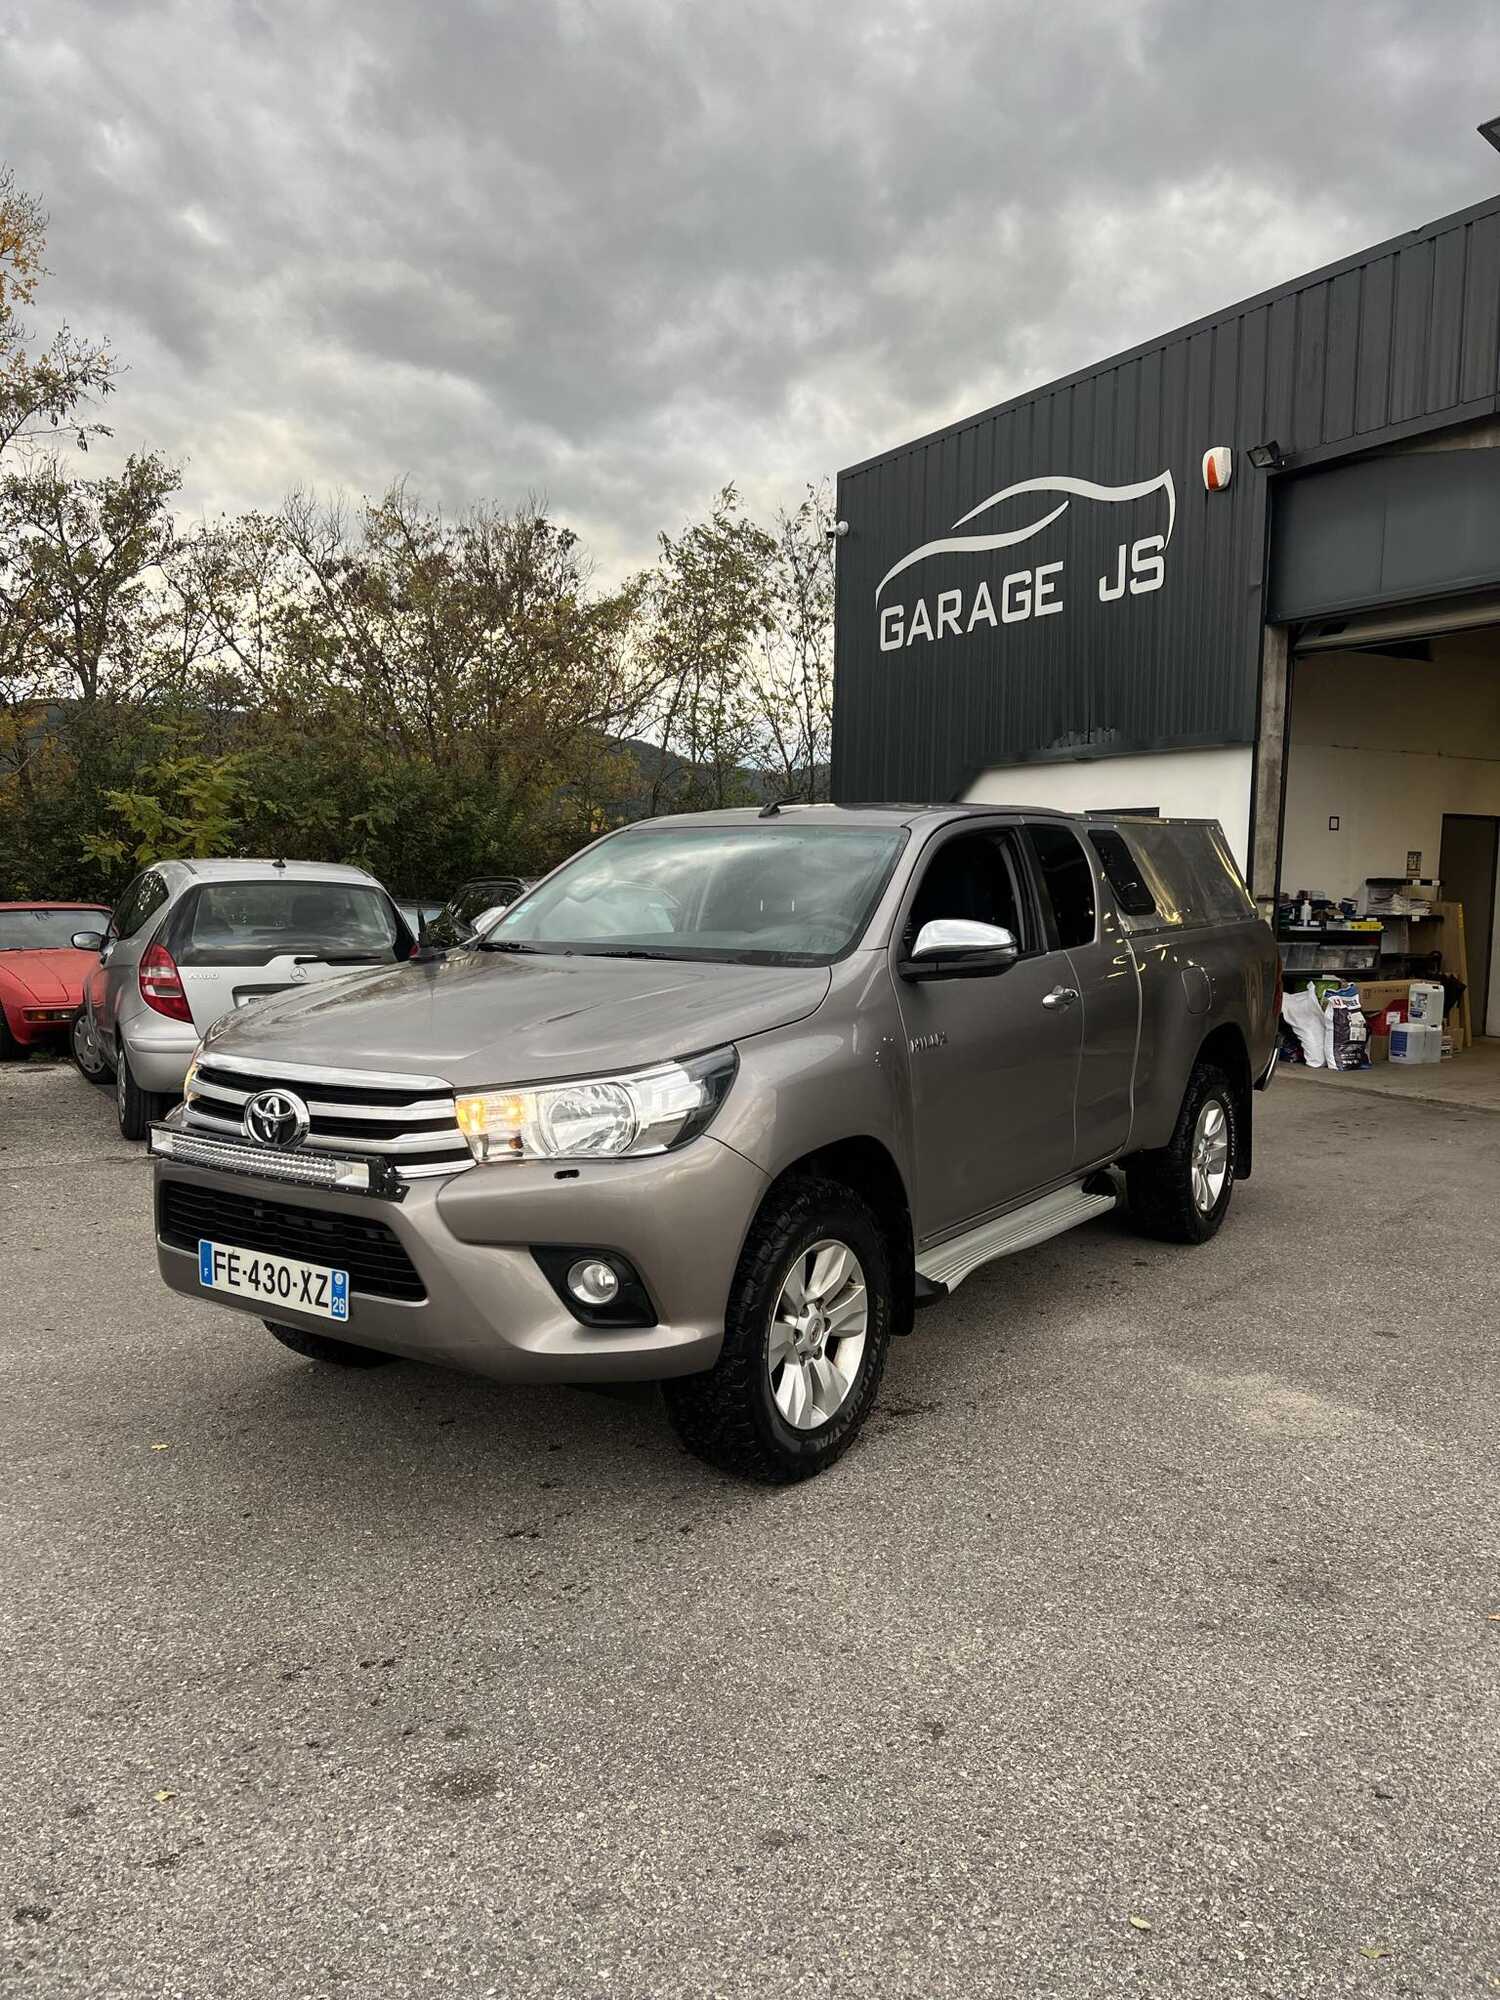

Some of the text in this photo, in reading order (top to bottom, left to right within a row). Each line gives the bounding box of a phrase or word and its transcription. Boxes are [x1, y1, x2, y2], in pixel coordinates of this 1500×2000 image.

[880, 535, 1165, 651] GARAGE JS
[214, 1250, 329, 1308] FE-430-XZ
[332, 1296, 346, 1314] 26
